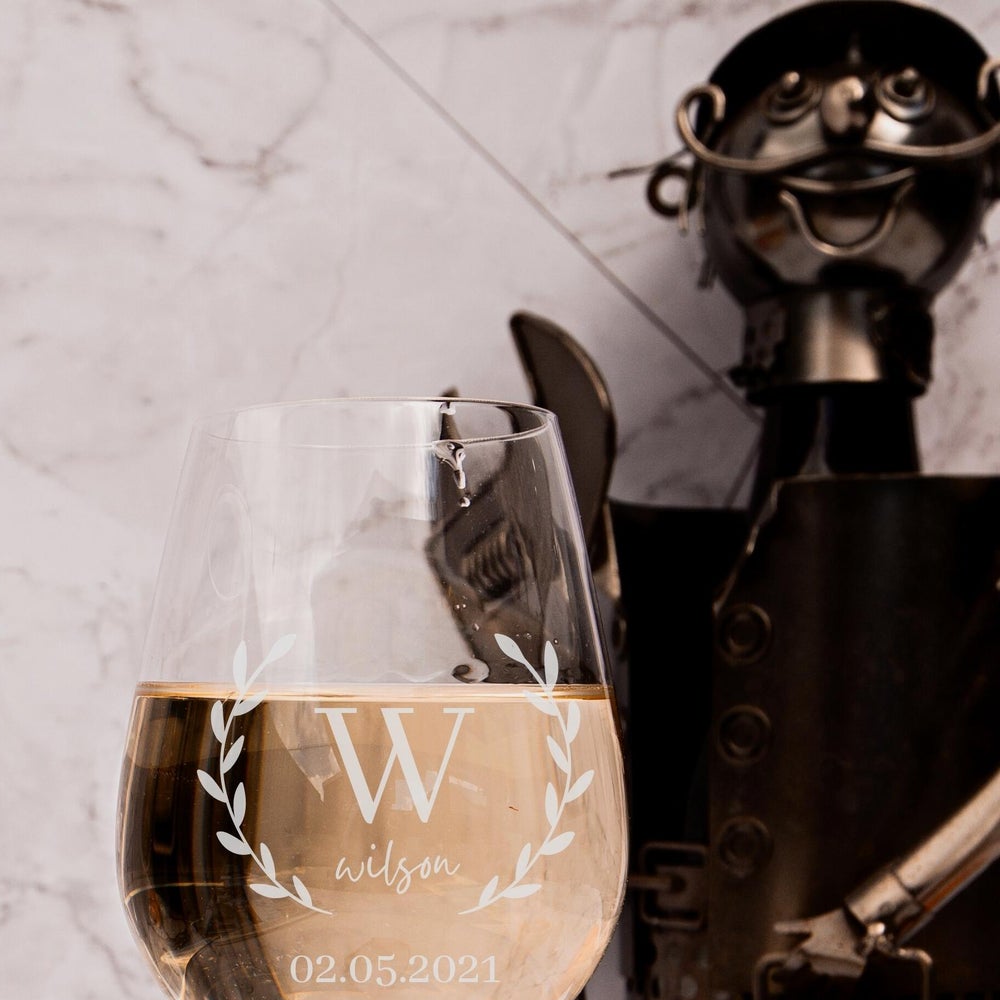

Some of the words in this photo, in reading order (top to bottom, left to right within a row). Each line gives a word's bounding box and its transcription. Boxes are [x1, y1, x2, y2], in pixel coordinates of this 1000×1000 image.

[315, 707, 475, 824] W
[335, 839, 461, 895] wilson
[290, 954, 500, 987] 02.05.2021
